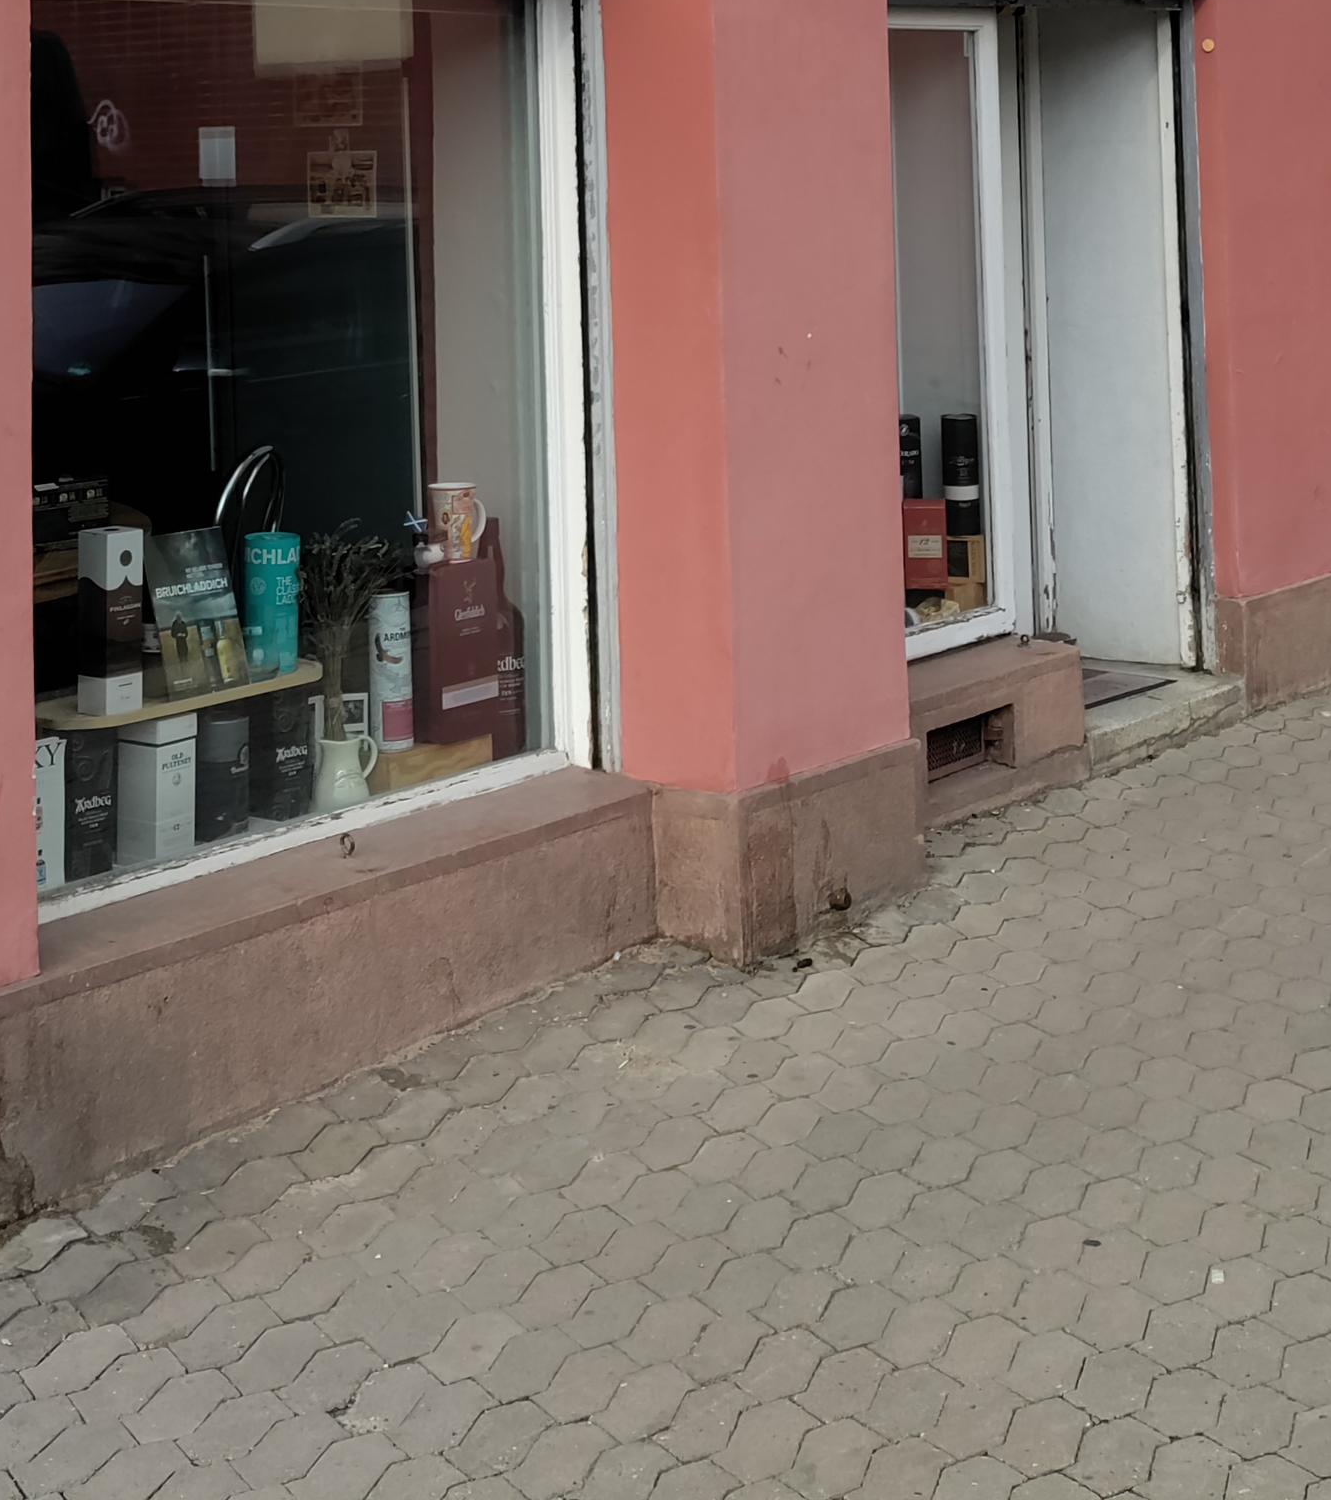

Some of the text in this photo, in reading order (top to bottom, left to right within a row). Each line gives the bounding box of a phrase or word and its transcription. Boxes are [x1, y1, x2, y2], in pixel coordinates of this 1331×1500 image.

[244, 546, 300, 565] ICHLA
[276, 576, 293, 586] THE
[155, 578, 228, 599] BRUICHLADDICH
[276, 583, 300, 596] CLAS
[276, 594, 296, 605] LAD
[384, 632, 410, 642] ARDM
